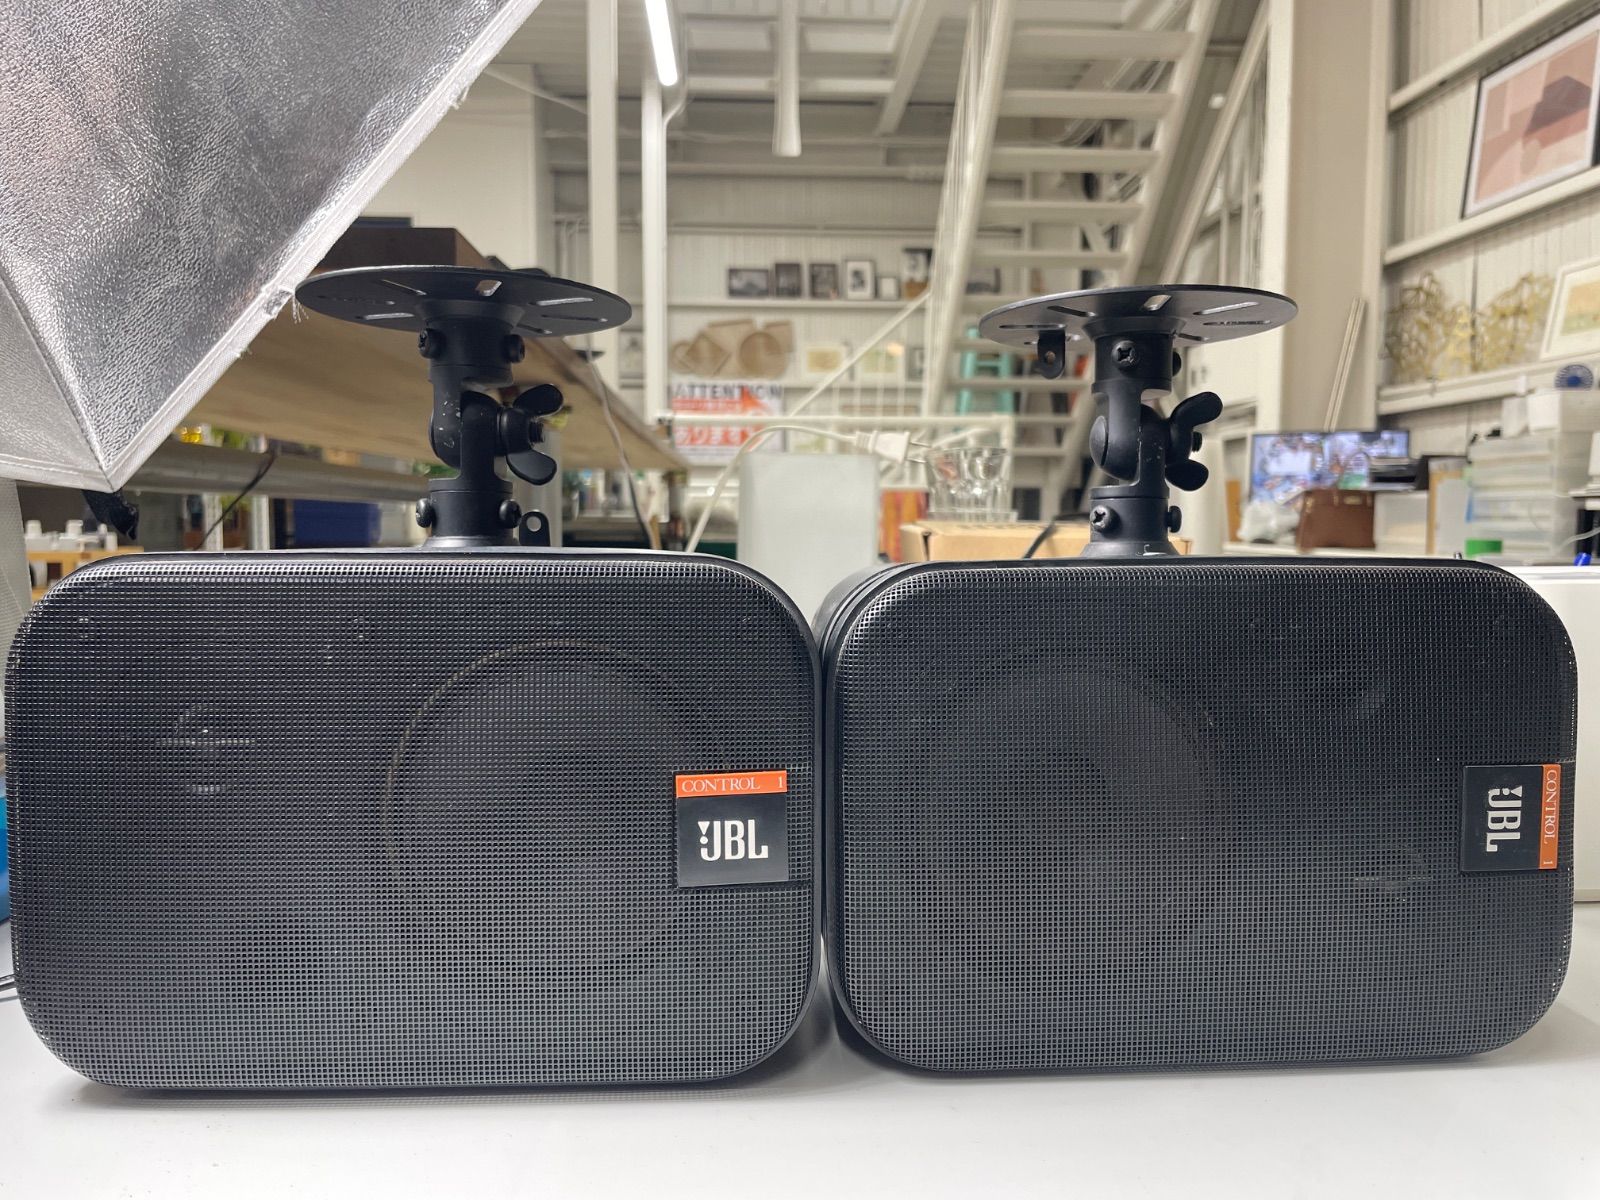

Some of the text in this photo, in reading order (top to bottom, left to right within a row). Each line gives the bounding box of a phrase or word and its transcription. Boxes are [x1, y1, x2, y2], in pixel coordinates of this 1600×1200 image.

[681, 776, 785, 793] CONTROL 1
[1543, 769, 1558, 845] CONTROL
[697, 819, 769, 861] JBL
[1486, 785, 1523, 853] JBL
